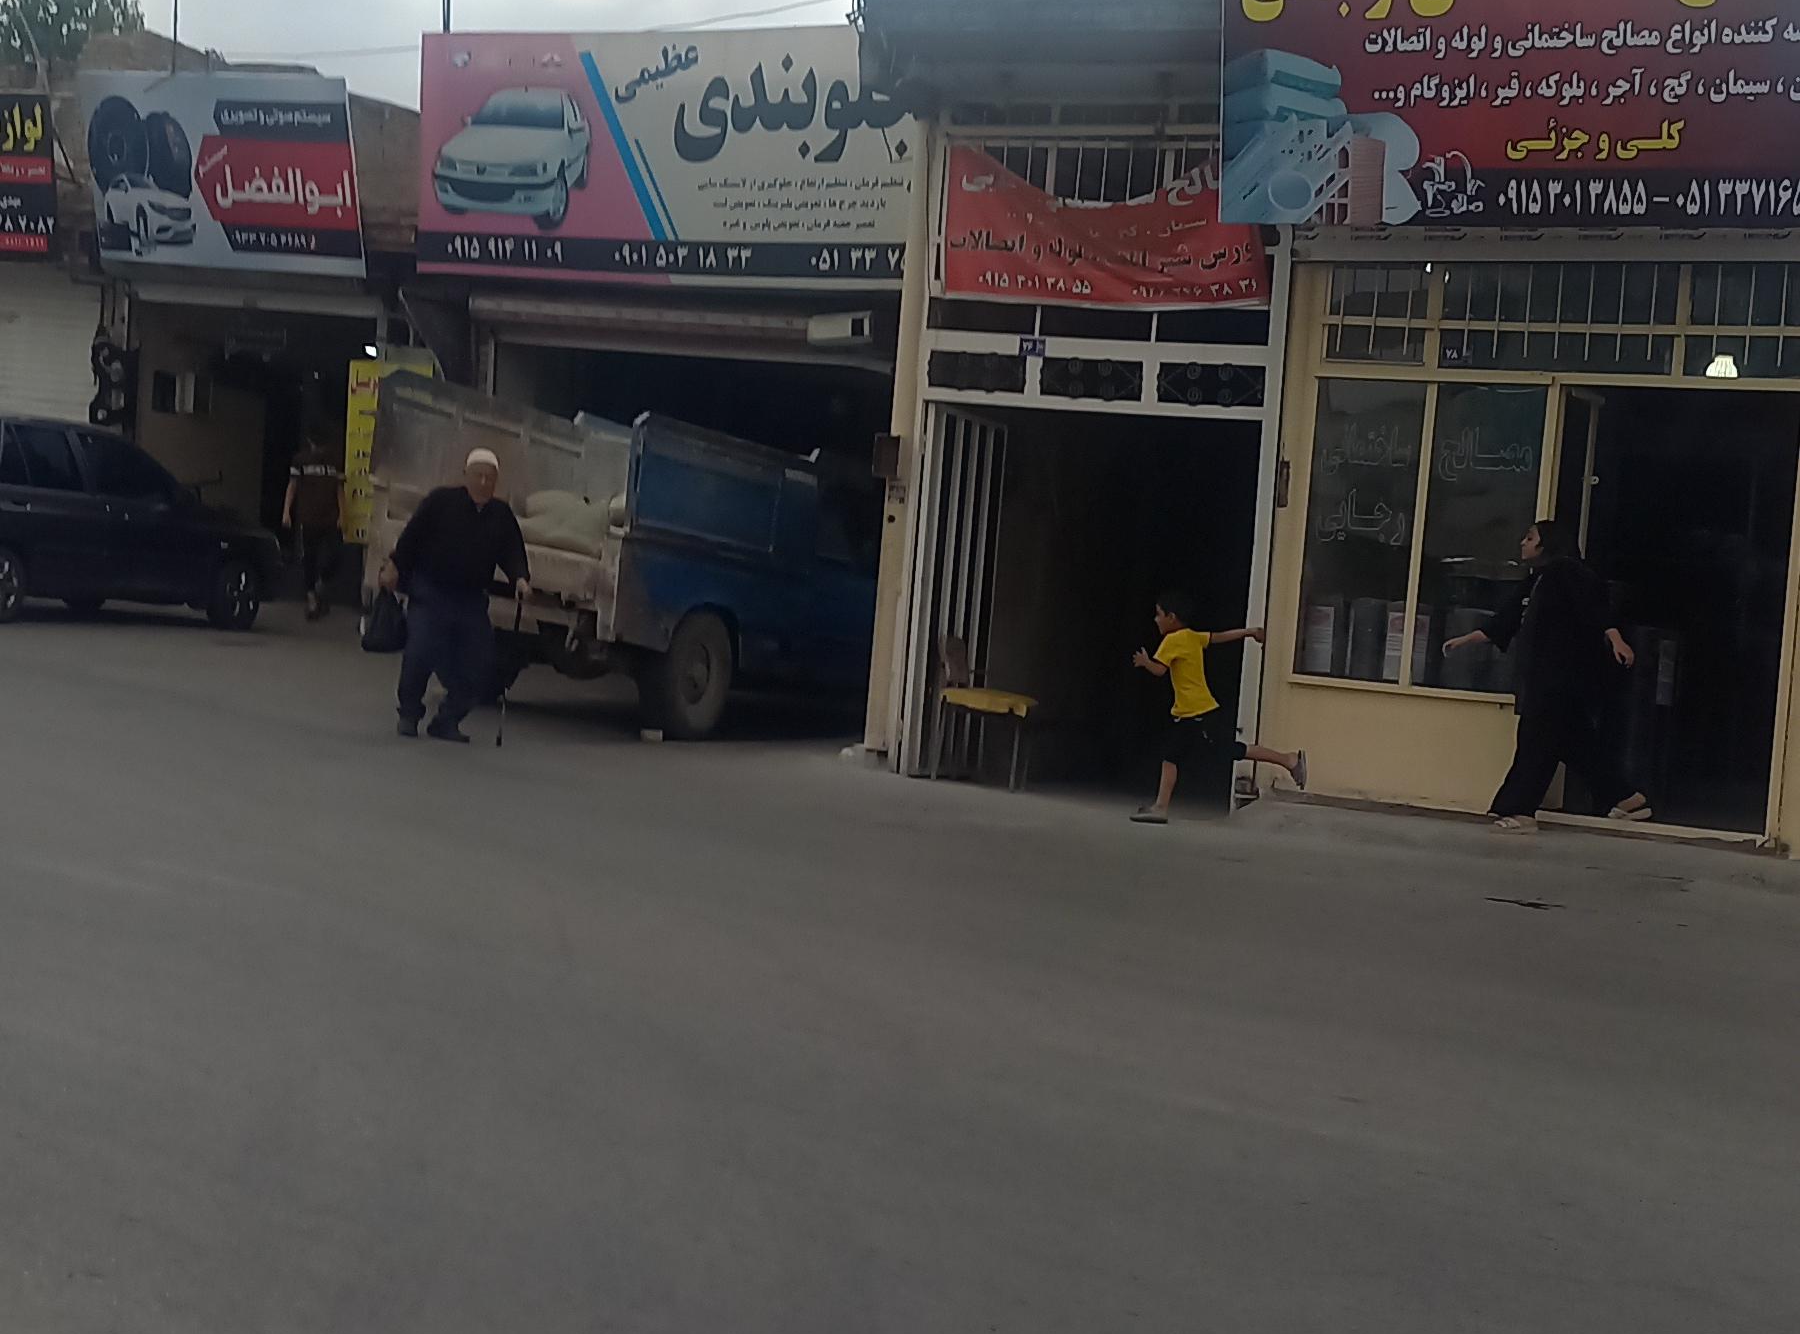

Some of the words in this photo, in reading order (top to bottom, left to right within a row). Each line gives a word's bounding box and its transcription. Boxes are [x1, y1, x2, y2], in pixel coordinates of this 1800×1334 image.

[1364, 25, 1431, 54] اتصالات
[1437, 35, 1446, 59] و
[1451, 25, 1487, 59] لوله
[1491, 34, 1502, 58] و
[1507, 22, 1596, 56] ساختمانی
[1601, 23, 1661, 54] مصالح
[1665, 18, 1717, 54] انواع
[1722, 17, 1778, 44] کننده
[615, 44, 699, 104] عظیمی
[1410, 73, 1476, 107] ایزوگام
[1491, 71, 1519, 106] قیر
[1536, 72, 1586, 106] بلوکه
[1601, 68, 1645, 105] آجر
[1709, 69, 1770, 103] سیمان
[2, 102, 42, 152] لواز
[1506, 118, 1590, 161] جزئی
[1616, 118, 1685, 160] کلی
[1598, 134, 1608, 160] و
[216, 164, 352, 218] ابوالفضل
[1167, 164, 1220, 206] الح
[1497, 179, 1541, 215] ۰۹۱۵
[1548, 179, 1581, 215] ۳۰۱
[1588, 179, 1647, 215] ۳۸۵۵
[1676, 178, 1709, 216] ۰۵۱
[1718, 178, 1800, 216] ۳۳۷۱۶۵
[447, 234, 480, 259] ۰۹۱۵
[524, 238, 537, 262] ۱۱
[546, 240, 563, 263] ۰۹
[614, 242, 647, 267] ۰۹۰۱
[655, 244, 689, 268] ۵۰۳
[698, 246, 717, 268] ۱۸
[727, 246, 753, 269] ۳۳
[811, 248, 839, 271] ۰۵۱
[850, 247, 877, 271] ۳۳
[887, 247, 904, 271] ۷
[1072, 279, 1091, 294] ۵۵
